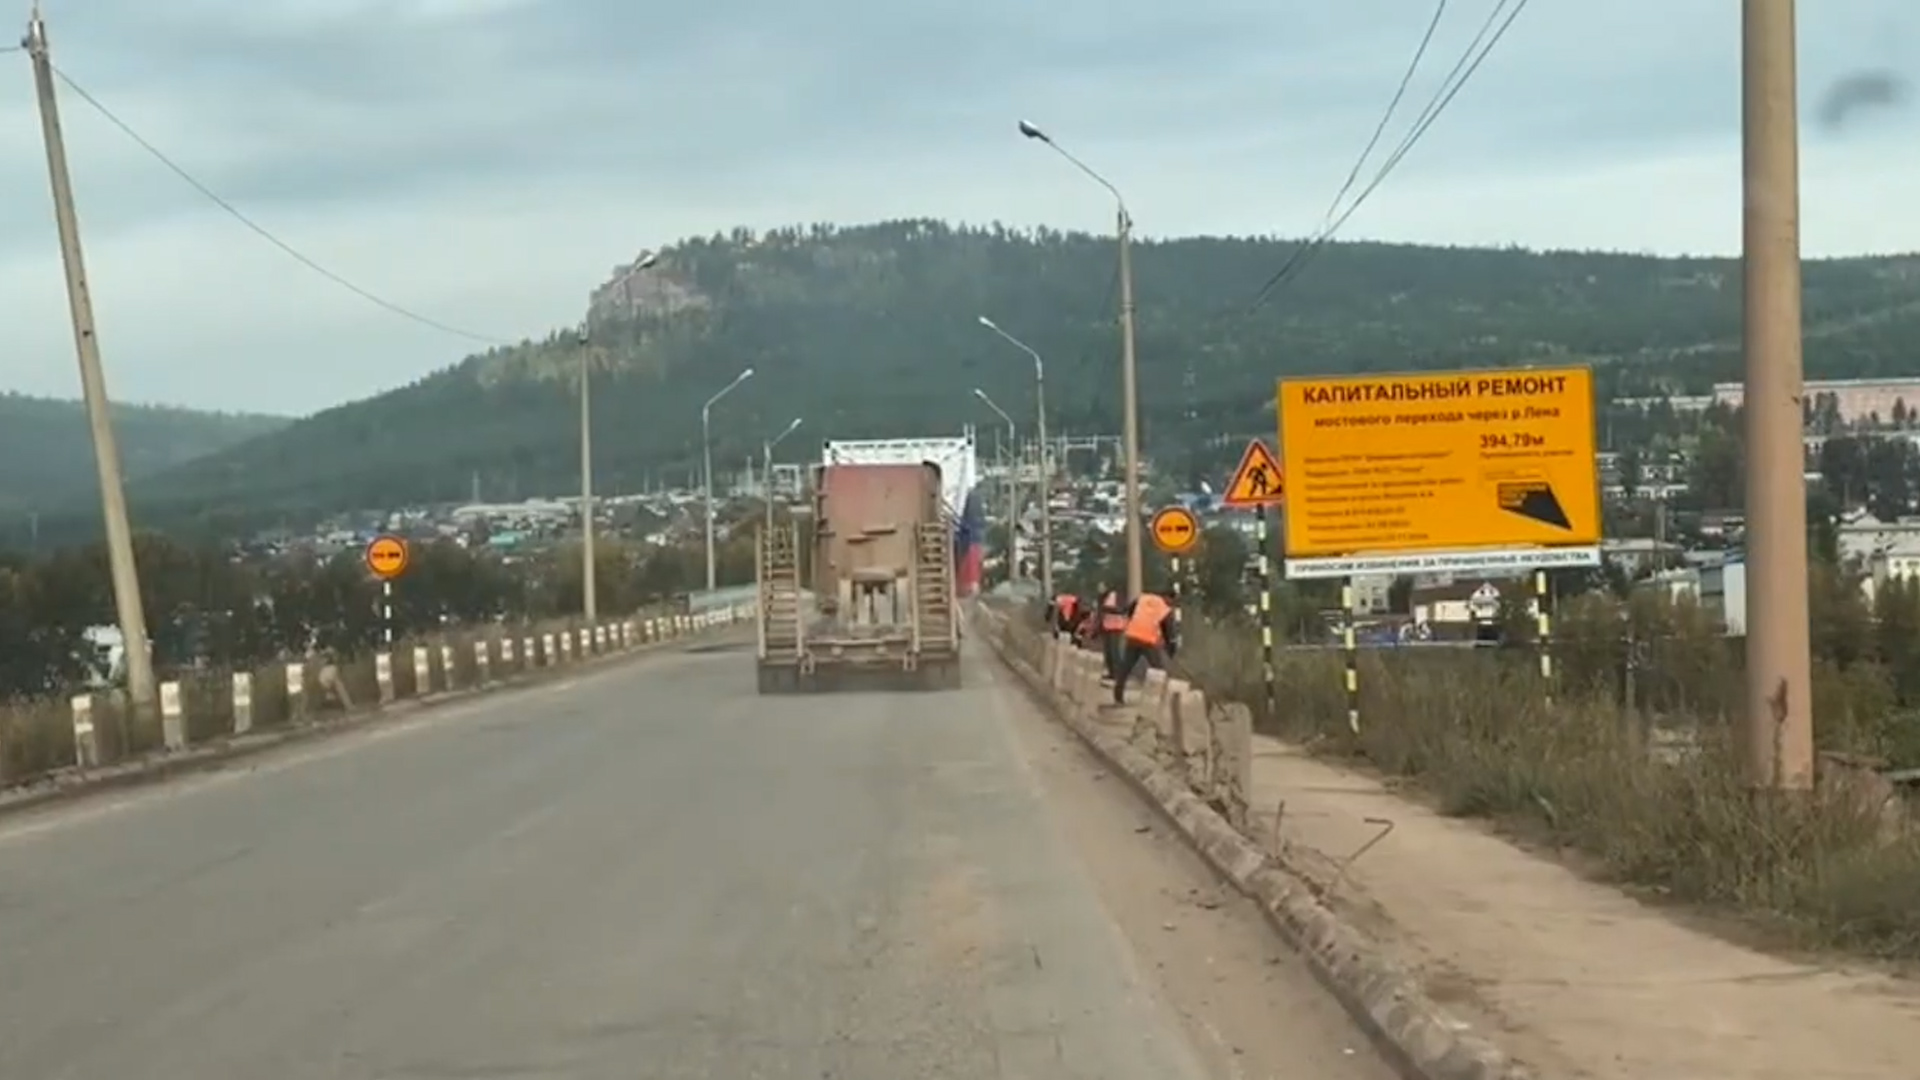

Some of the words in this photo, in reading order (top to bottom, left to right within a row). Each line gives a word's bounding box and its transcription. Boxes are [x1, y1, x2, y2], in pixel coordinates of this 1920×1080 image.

[1303, 379, 1471, 404] КАПИТАЛЬНЫЙ
[1477, 377, 1566, 397] РЕМОНТ
[1314, 415, 1391, 428] мостового
[1395, 411, 1464, 425] перехода
